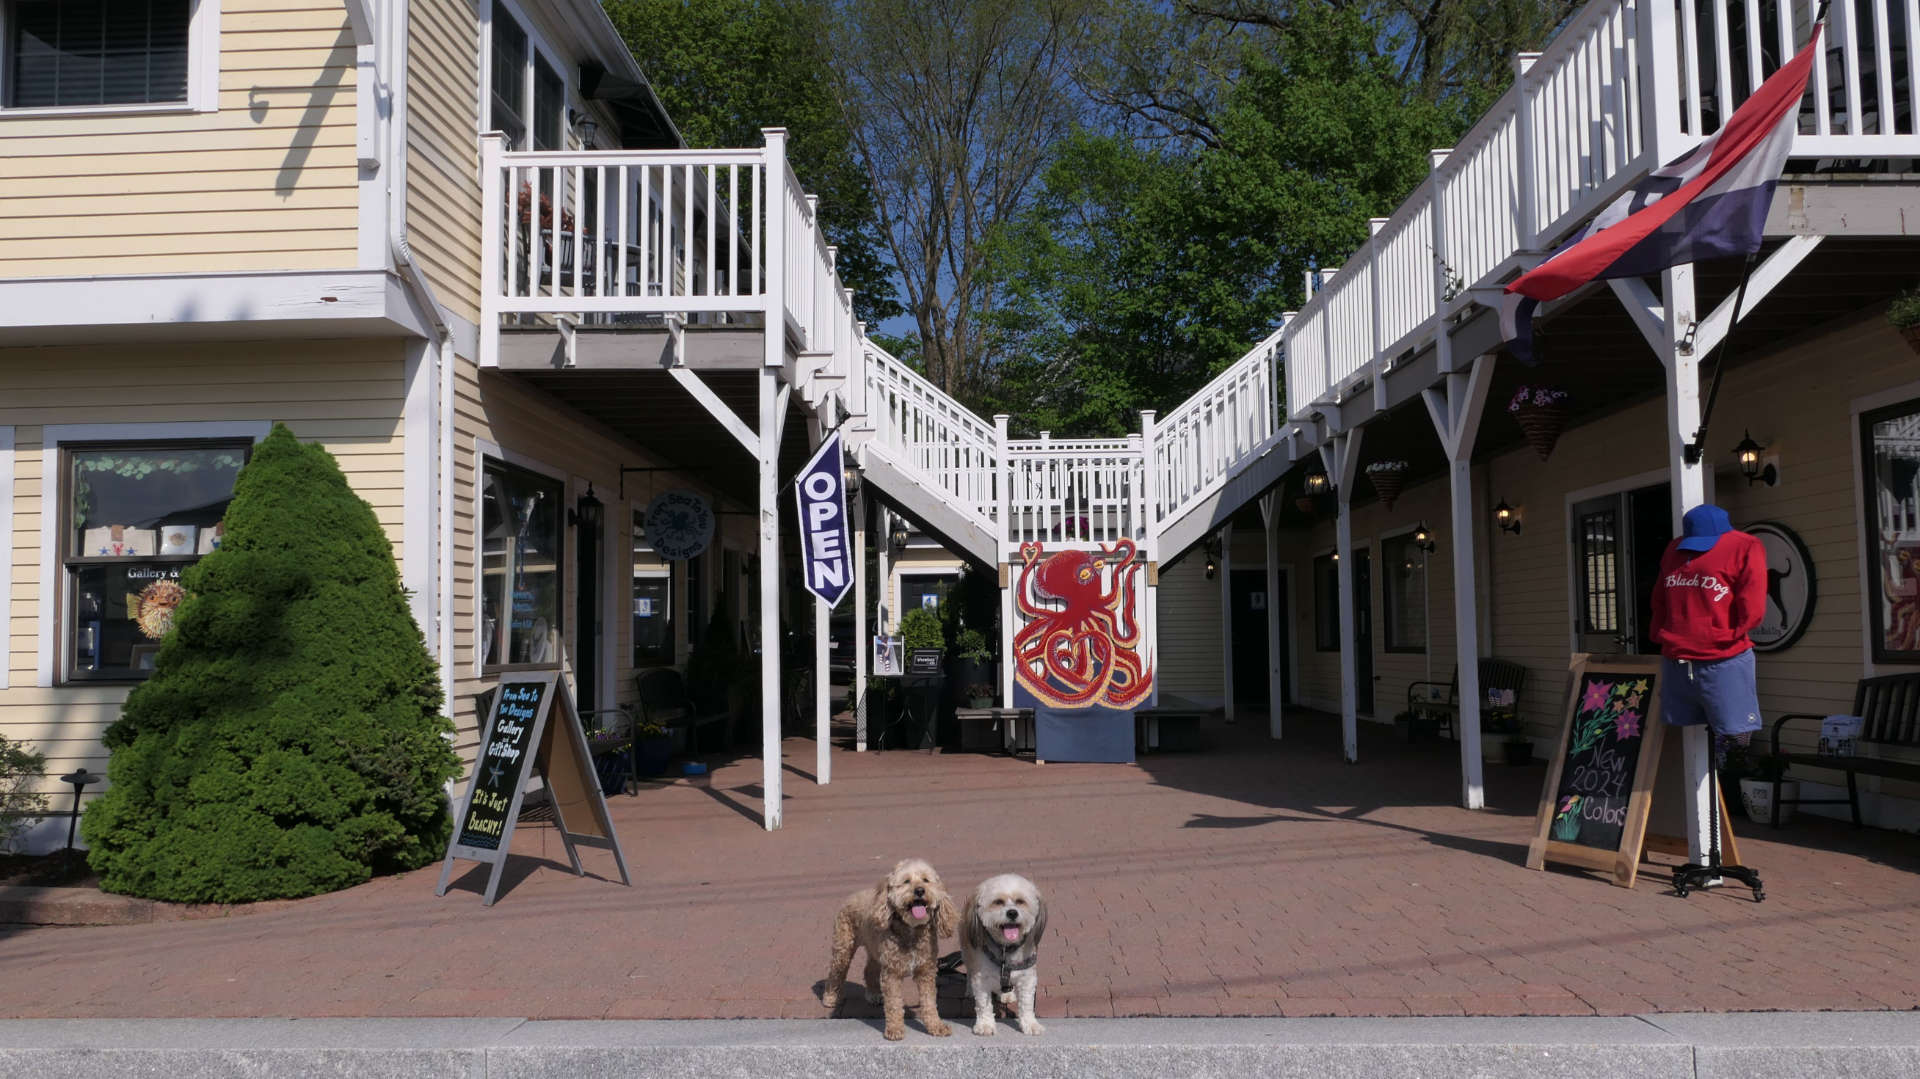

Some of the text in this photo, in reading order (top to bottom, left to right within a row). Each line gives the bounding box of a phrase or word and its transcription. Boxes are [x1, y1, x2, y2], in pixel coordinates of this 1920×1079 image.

[668, 494, 692, 505] Sea
[804, 471, 844, 589] OPEN
[655, 537, 703, 559] Designs
[128, 568, 178, 579] Gallery &
[1665, 573, 1729, 602] Black Dog
[497, 719, 524, 744] Gallery
[1569, 765, 1627, 800] 2024
[1584, 796, 1627, 826] Colors
